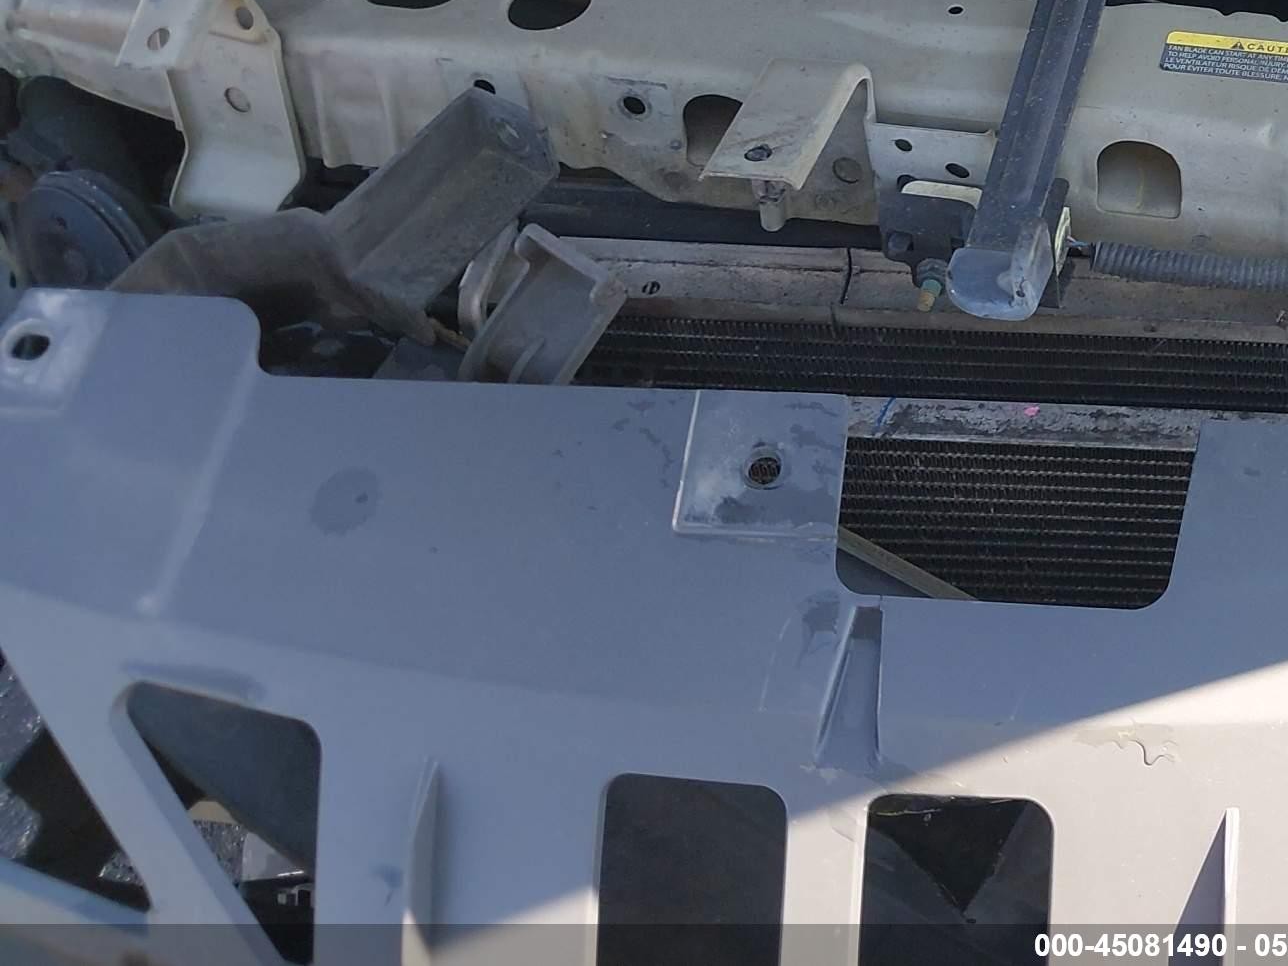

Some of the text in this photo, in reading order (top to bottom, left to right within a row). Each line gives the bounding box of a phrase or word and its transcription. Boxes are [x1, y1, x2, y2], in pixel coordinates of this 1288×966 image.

[1175, 57, 1227, 68] VENTILATEUR
[1228, 63, 1257, 71] RISQUE
[1198, 54, 1221, 62] AVOID
[1222, 56, 1259, 66] PERSONAL
[1163, 62, 1186, 70] POUR
[1215, 68, 1240, 76] TOUTE
